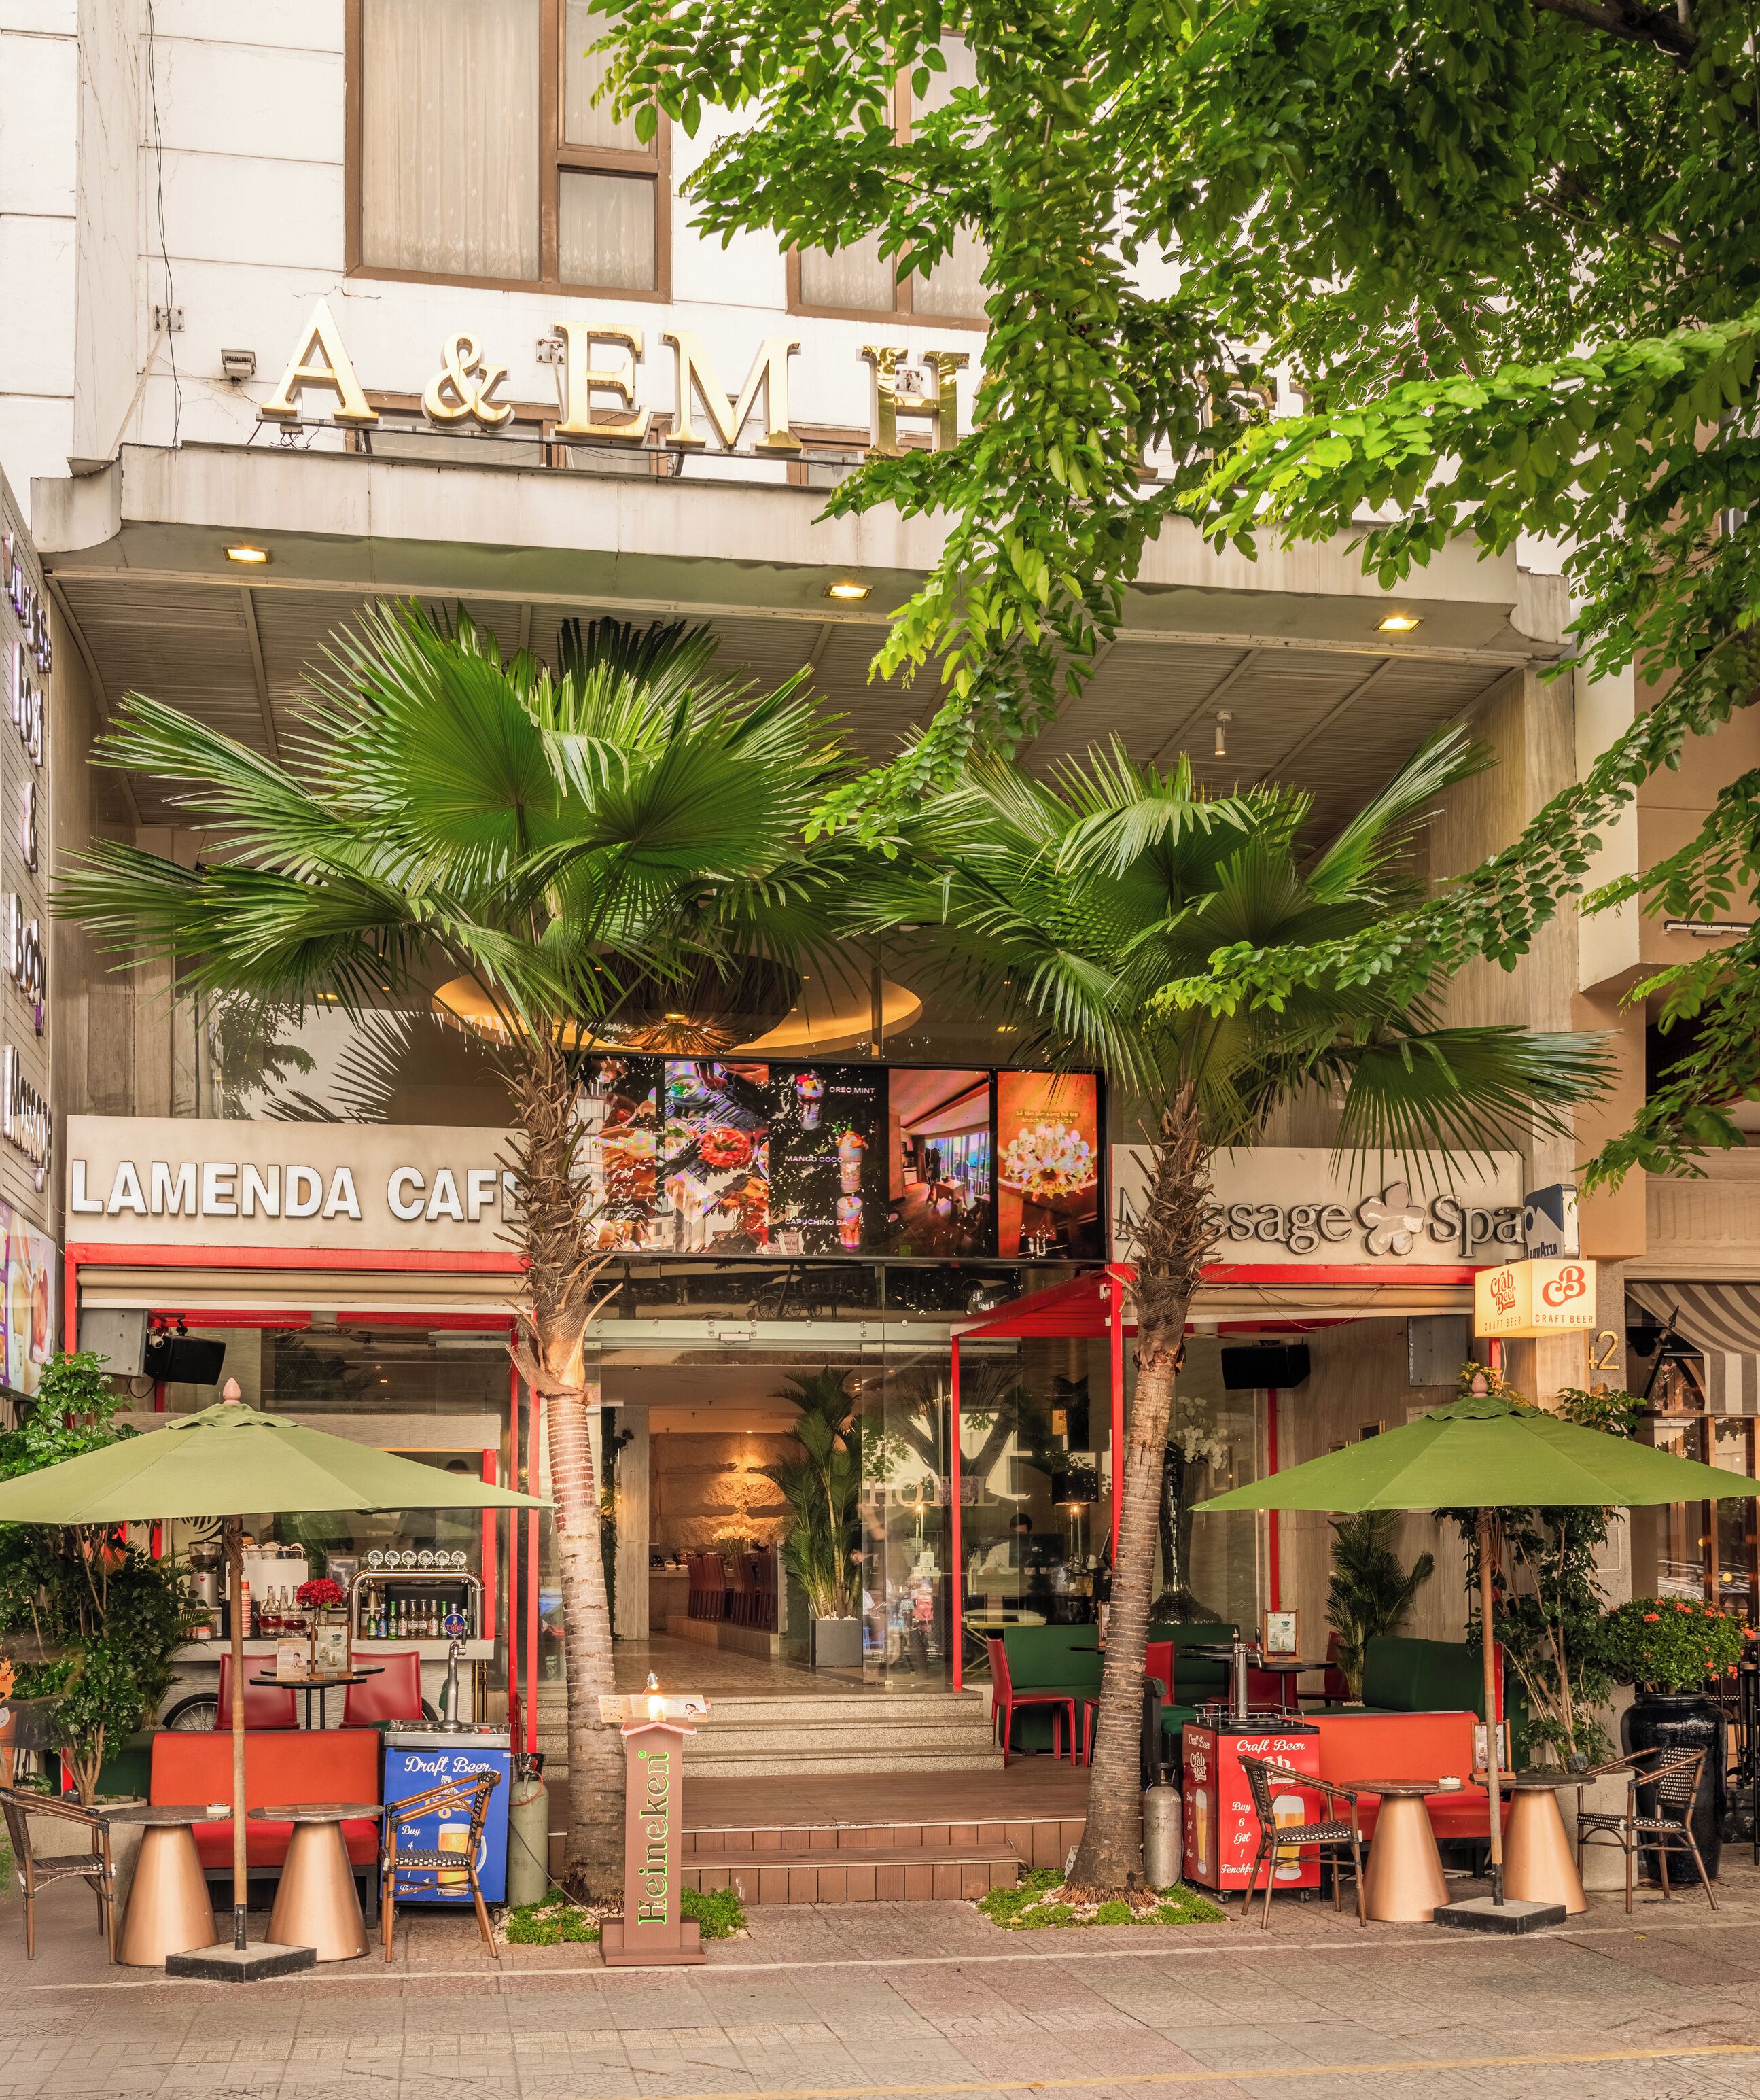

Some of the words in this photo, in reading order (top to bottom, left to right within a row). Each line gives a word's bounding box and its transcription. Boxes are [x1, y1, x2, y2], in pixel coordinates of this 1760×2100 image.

[261, 298, 379, 424] A
[423, 332, 513, 431] &
[553, 321, 802, 453] EM
[10, 892, 47, 1038] Body
[71, 1159, 362, 1221] LAMENDA
[1114, 1187, 1352, 1255] Mssage
[1430, 1194, 1526, 1258] Spa
[1530, 1241, 1558, 1259] LAVAZZA
[1490, 1269, 1514, 1299] Crab
[1496, 1286, 1516, 1316] Beer
[1485, 1320, 1503, 1331] CRAFT
[1506, 1316, 1521, 1327] BEER
[1535, 1314, 1566, 1323] CRAFT
[1570, 1314, 1594, 1323] BEER
[1189, 1733, 1199, 1749] Craft
[1199, 1736, 1210, 1750] Beer
[1236, 1739, 1270, 1754] Craft
[1273, 1739, 1306, 1751] Beer
[404, 1755, 449, 1777] Draft
[452, 1757, 491, 1773] Beer
[1190, 1751, 1205, 1768] Crab
[1193, 1765, 1207, 1781] Beer
[1231, 1801, 1252, 1813] Buy
[1238, 1817, 1245, 1827] 6
[401, 1825, 421, 1837] Buy
[637, 1751, 669, 1925] Heineken
[1233, 1832, 1252, 1844] Get
[407, 1840, 414, 1849] 4
[1239, 1849, 1244, 1858] 1
[1220, 1863, 1263, 1876] Fenchfrs
